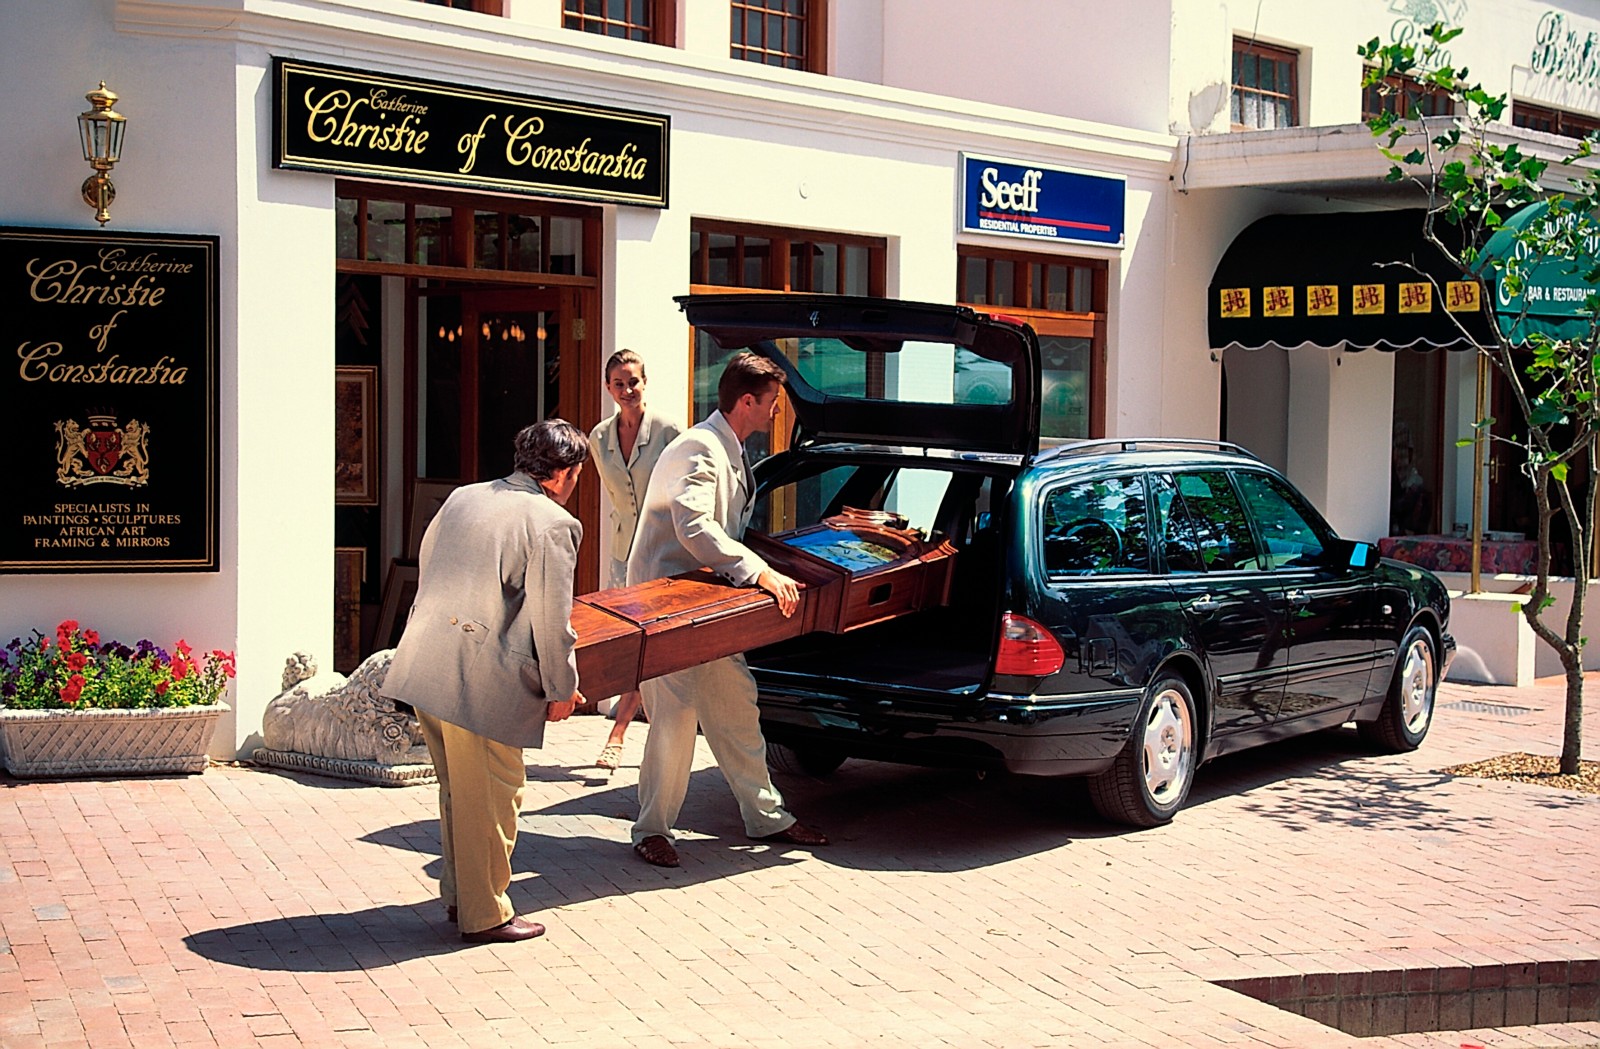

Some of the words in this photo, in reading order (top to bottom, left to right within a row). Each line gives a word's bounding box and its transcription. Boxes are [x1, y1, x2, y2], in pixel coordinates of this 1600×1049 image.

[369, 87, 429, 115] Catherine
[304, 86, 430, 154] Christie
[457, 114, 496, 173] of
[504, 114, 648, 180] Constantia
[981, 167, 1043, 213] Seeff
[979, 218, 1019, 232] RESIDENTIAL
[1020, 223, 1058, 237] PROPERTIES
[98, 248, 193, 273] Catherine
[26, 257, 166, 306] Christie
[1528, 286, 1543, 301] BAR
[1544, 287, 1550, 300] &
[89, 310, 128, 353] of
[17, 341, 189, 384] Constantia
[23, 515, 90, 525] PAINTINGS
[101, 515, 181, 525] SCULPTURES
[54, 503, 131, 514] SPECIALISTS
[136, 503, 151, 513] IN
[34, 538, 95, 548] FRAMING
[100, 537, 110, 547] &
[116, 537, 171, 547] MIRRORS
[59, 526, 116, 536] AFRICAN
[121, 526, 147, 536] ART
